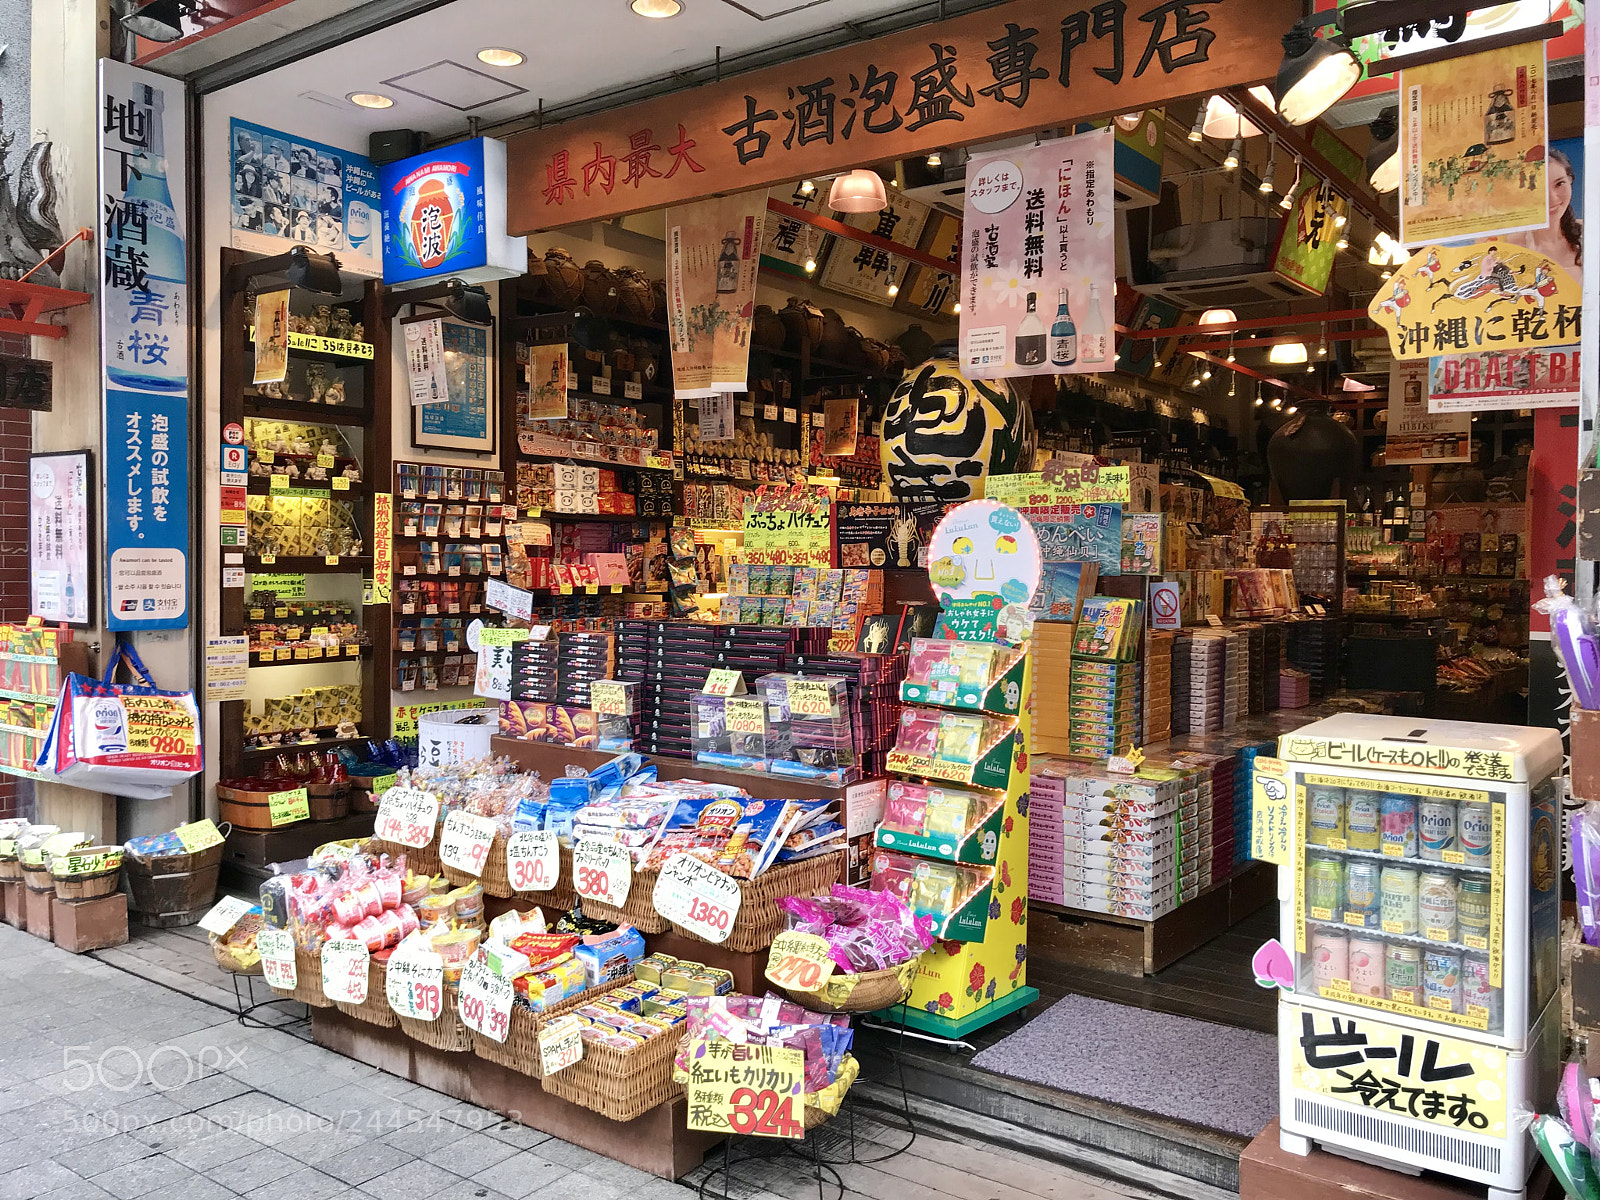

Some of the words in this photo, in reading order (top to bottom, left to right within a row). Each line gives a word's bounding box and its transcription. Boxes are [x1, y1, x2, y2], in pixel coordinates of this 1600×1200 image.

[541, 122, 705, 206] 県内最大
[723, 0, 1217, 165] 古酒泡盛専門店
[346, 164, 376, 180] 沖縄には、
[346, 174, 367, 187] 沖縄の
[405, 167, 431, 186] AWANAMI
[978, 173, 1009, 187] 詳しくは
[104, 95, 149, 292] 地下酒蔵
[345, 184, 382, 200] ビールがある
[970, 181, 1021, 197] スタッフまで。
[1085, 160, 1095, 226] ※指定あわもり
[350, 208, 370, 221] Orion
[1057, 159, 1074, 271] 「にほん」以上買うと
[421, 204, 443, 261] 泡波
[1024, 188, 1045, 279] 送料無料
[128, 289, 170, 366] 青桜
[1398, 304, 1583, 354] 沖縄に乾杯
[1444, 354, 1541, 391] DRAFT
[125, 411, 145, 540] オススメします。
[151, 413, 169, 522] 泡盛の試飲を
[747, 512, 785, 530] ぷっちょ
[787, 512, 830, 528] ハイチュウ
[1036, 525, 1104, 543] めんべい
[947, 609, 994, 617] おしゃれ女子に
[951, 619, 980, 629] ウケて
[958, 630, 996, 641] マスク!!
[149, 735, 194, 755] 980円
[1465, 750, 1509, 768] 発送
[1462, 763, 1513, 780] できます。
[708, 807, 735, 816] オリオン
[1421, 815, 1451, 827] Orion
[510, 845, 549, 857] 塩ちんすこう
[515, 860, 544, 888] 300
[578, 866, 609, 896] 380
[1300, 1012, 1475, 1083] ビール
[690, 1060, 794, 1095] 紅いもカリカリ
[1331, 1069, 1489, 1129] 冷えてます。
